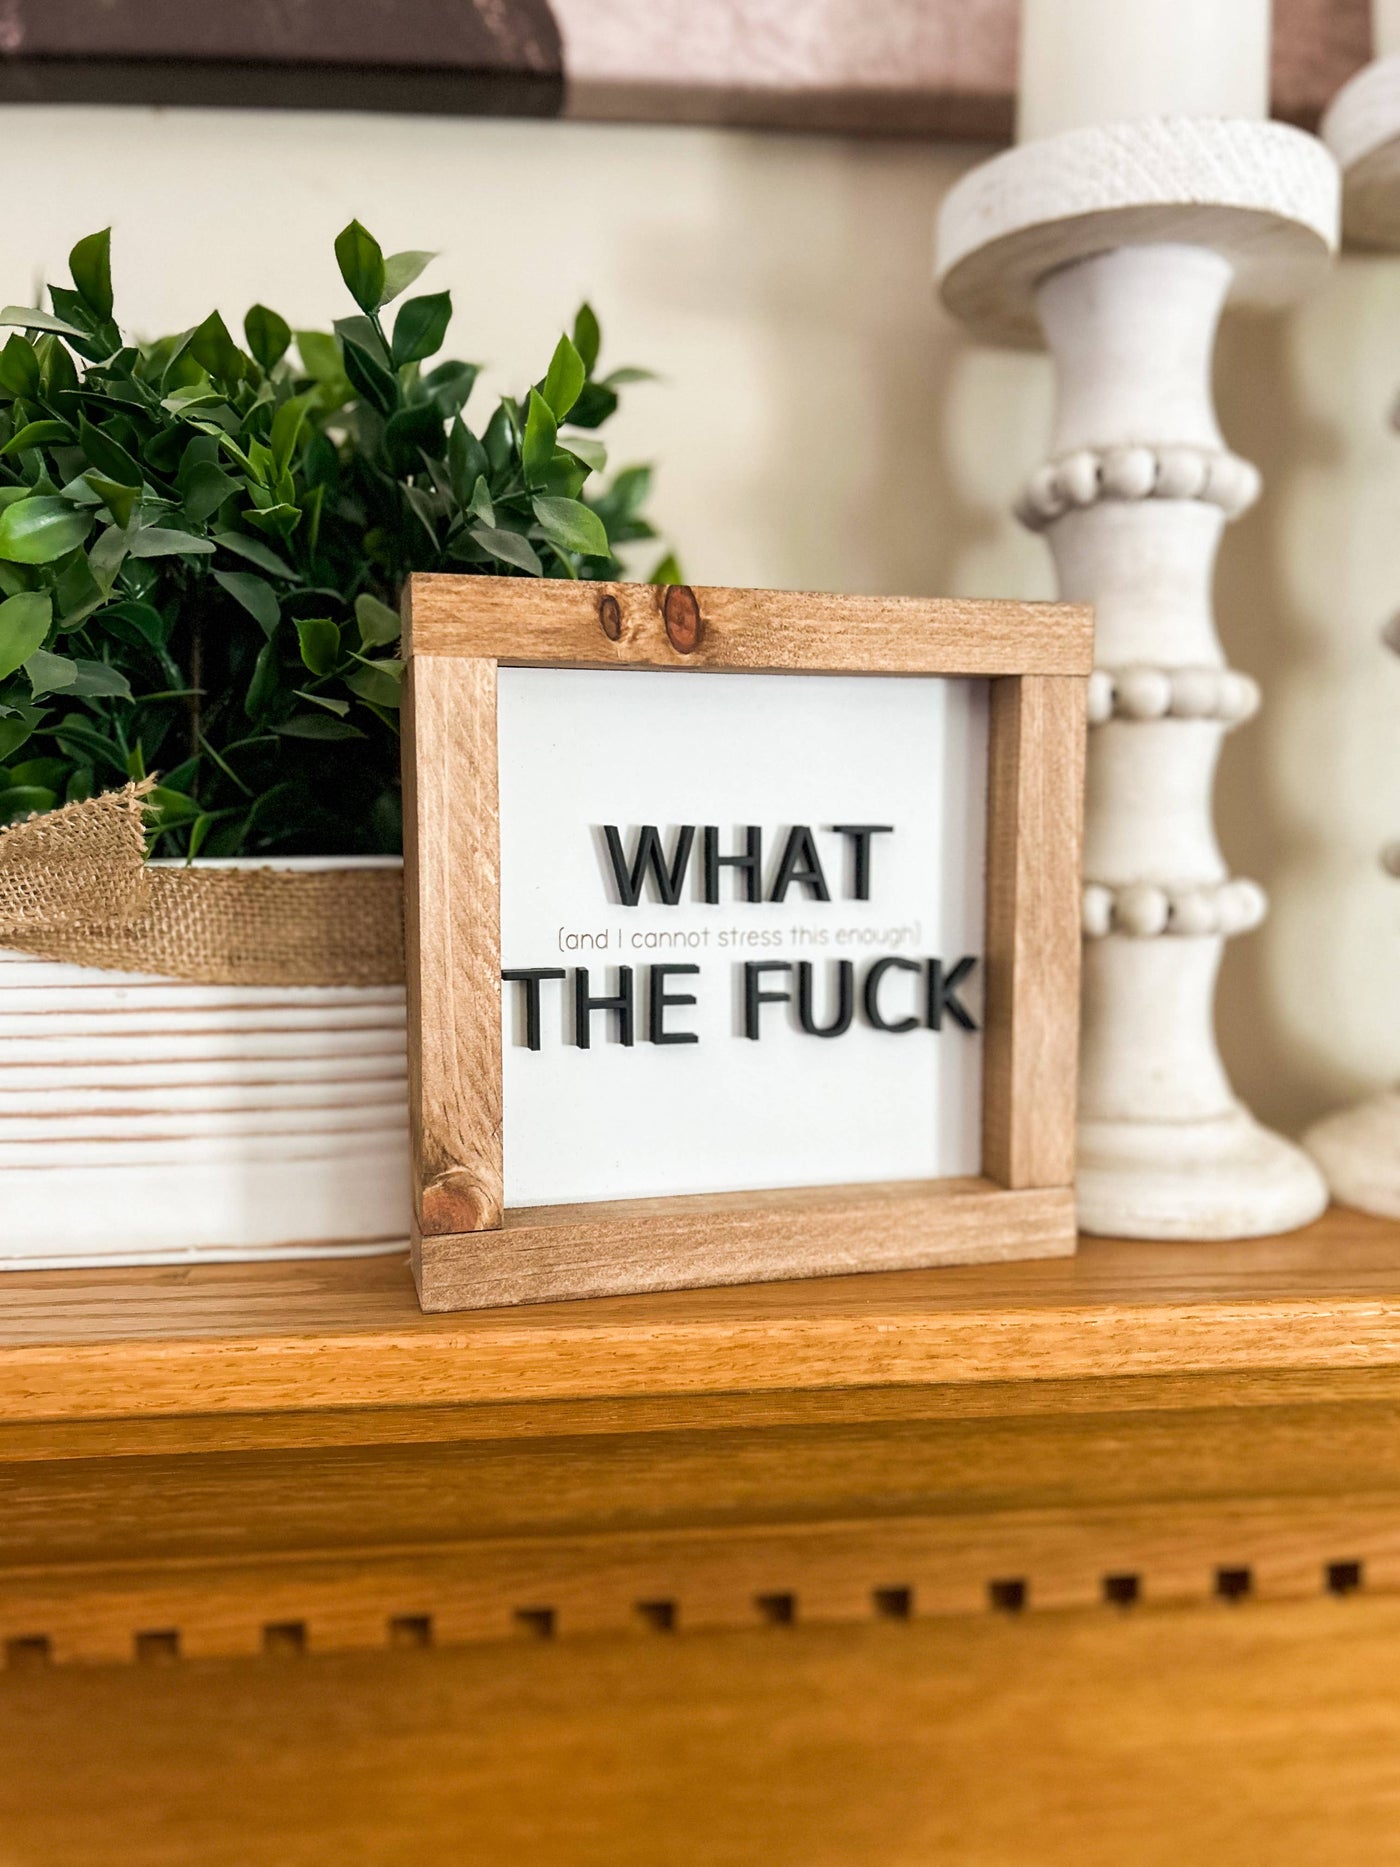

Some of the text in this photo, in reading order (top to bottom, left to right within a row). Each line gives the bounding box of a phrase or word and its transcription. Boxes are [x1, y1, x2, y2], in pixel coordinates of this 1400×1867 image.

[603, 825, 893, 906] WHAT
[558, 926, 609, 952] (and
[631, 926, 711, 949] cannot
[717, 925, 783, 947] stress
[789, 924, 830, 947] this
[835, 920, 922, 950] enough)
[501, 956, 981, 1051] THE FUCK
